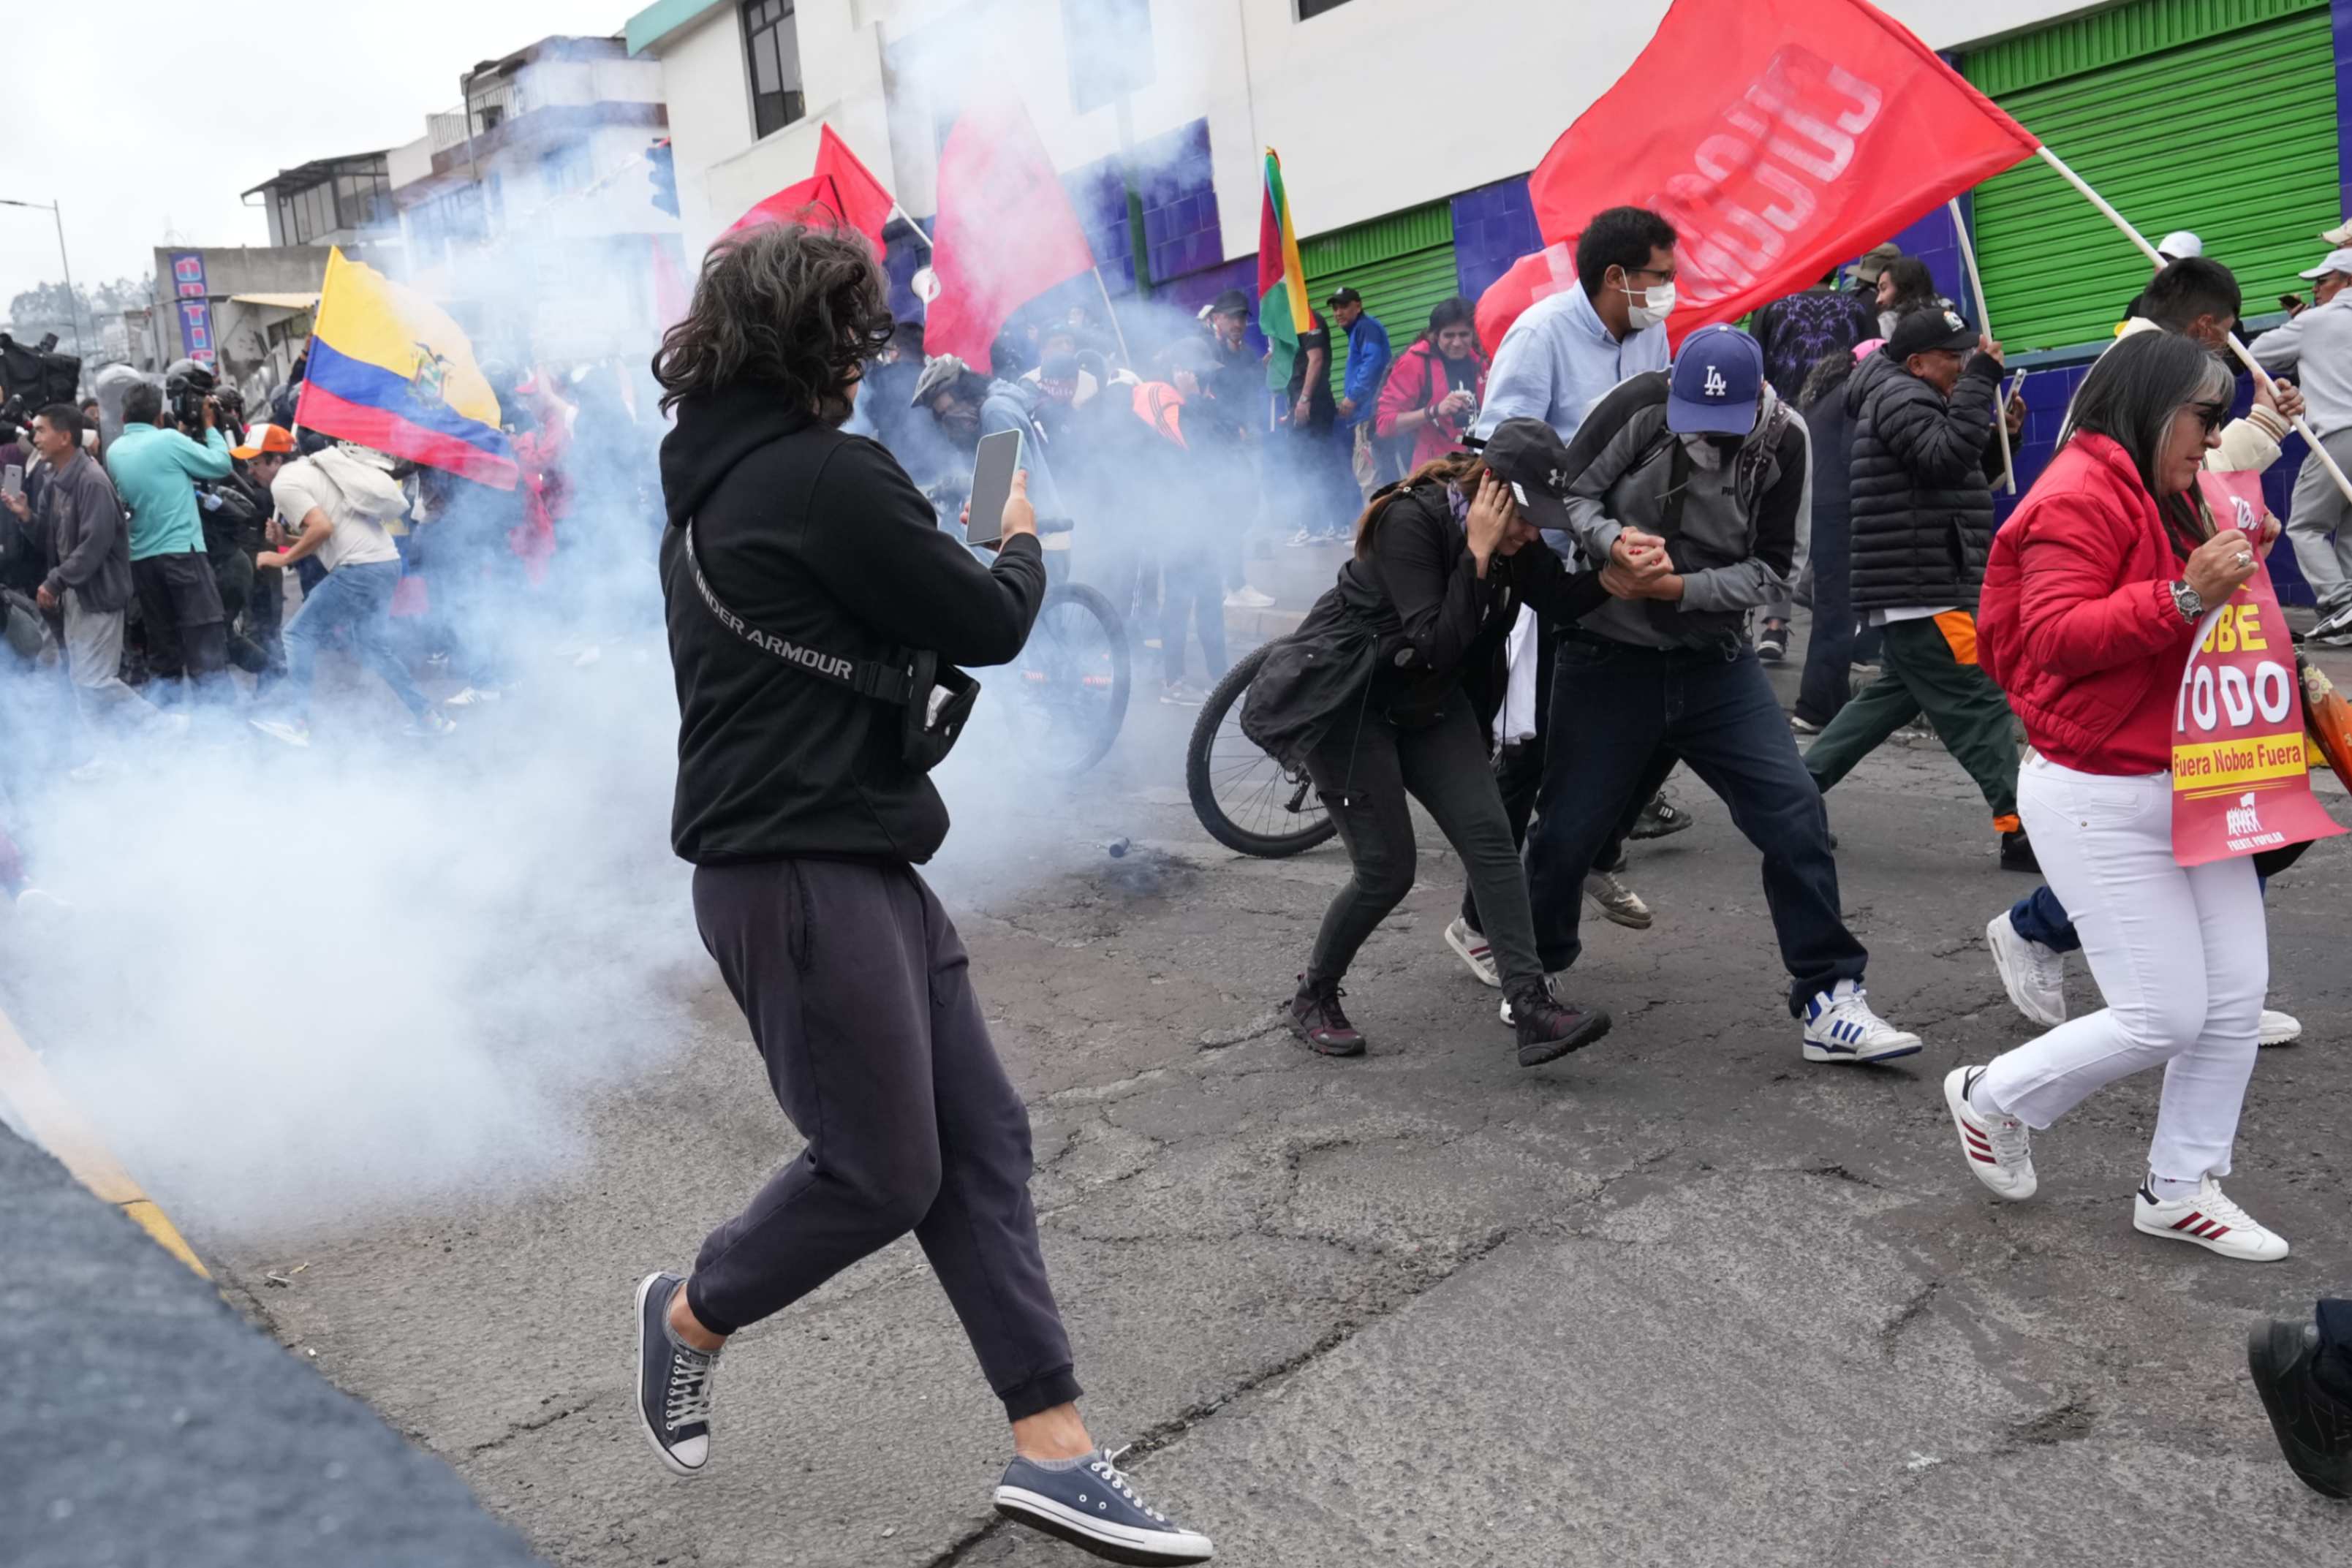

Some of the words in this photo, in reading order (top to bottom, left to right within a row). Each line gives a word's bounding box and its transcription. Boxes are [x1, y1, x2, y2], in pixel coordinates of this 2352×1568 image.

[1704, 366, 1726, 395] LA
[696, 569, 745, 635] UNDER
[746, 629, 853, 680] ARMOUR
[2177, 661, 2291, 731] TODO
[2174, 753, 2211, 778] Fuera
[2213, 747, 2253, 773] Noboa
[2257, 743, 2302, 767] Fuera
